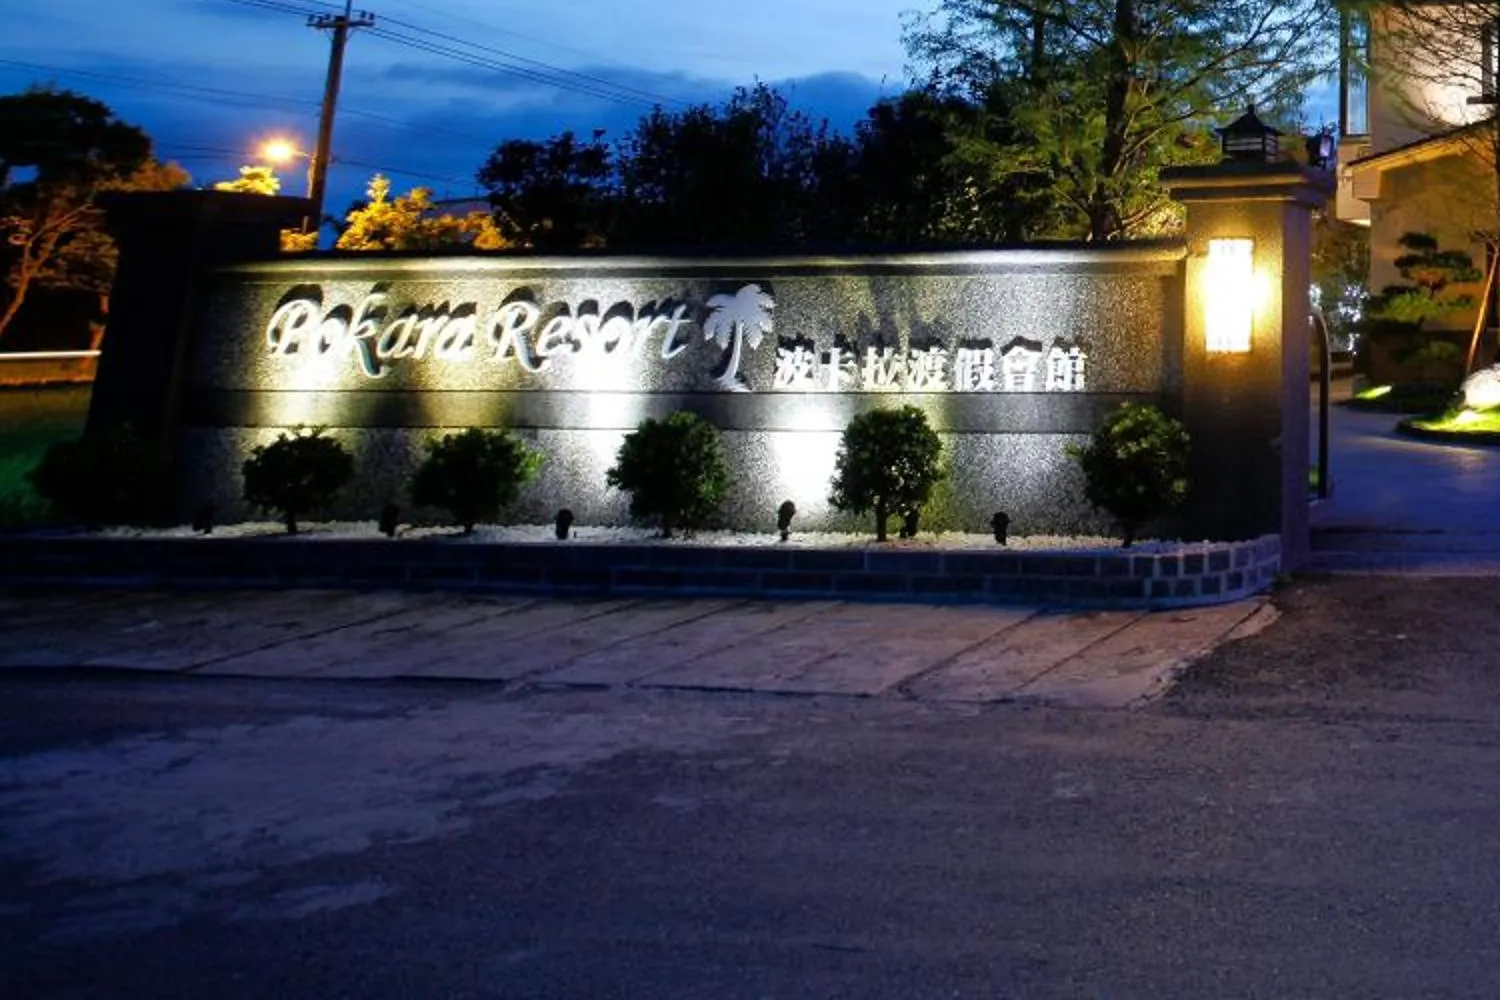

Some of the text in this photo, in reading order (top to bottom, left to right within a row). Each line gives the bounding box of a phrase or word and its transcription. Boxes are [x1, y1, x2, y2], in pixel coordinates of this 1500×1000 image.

[267, 294, 691, 377] Pokara Resort
[774, 346, 1088, 392] 波卡拉渡假會館
